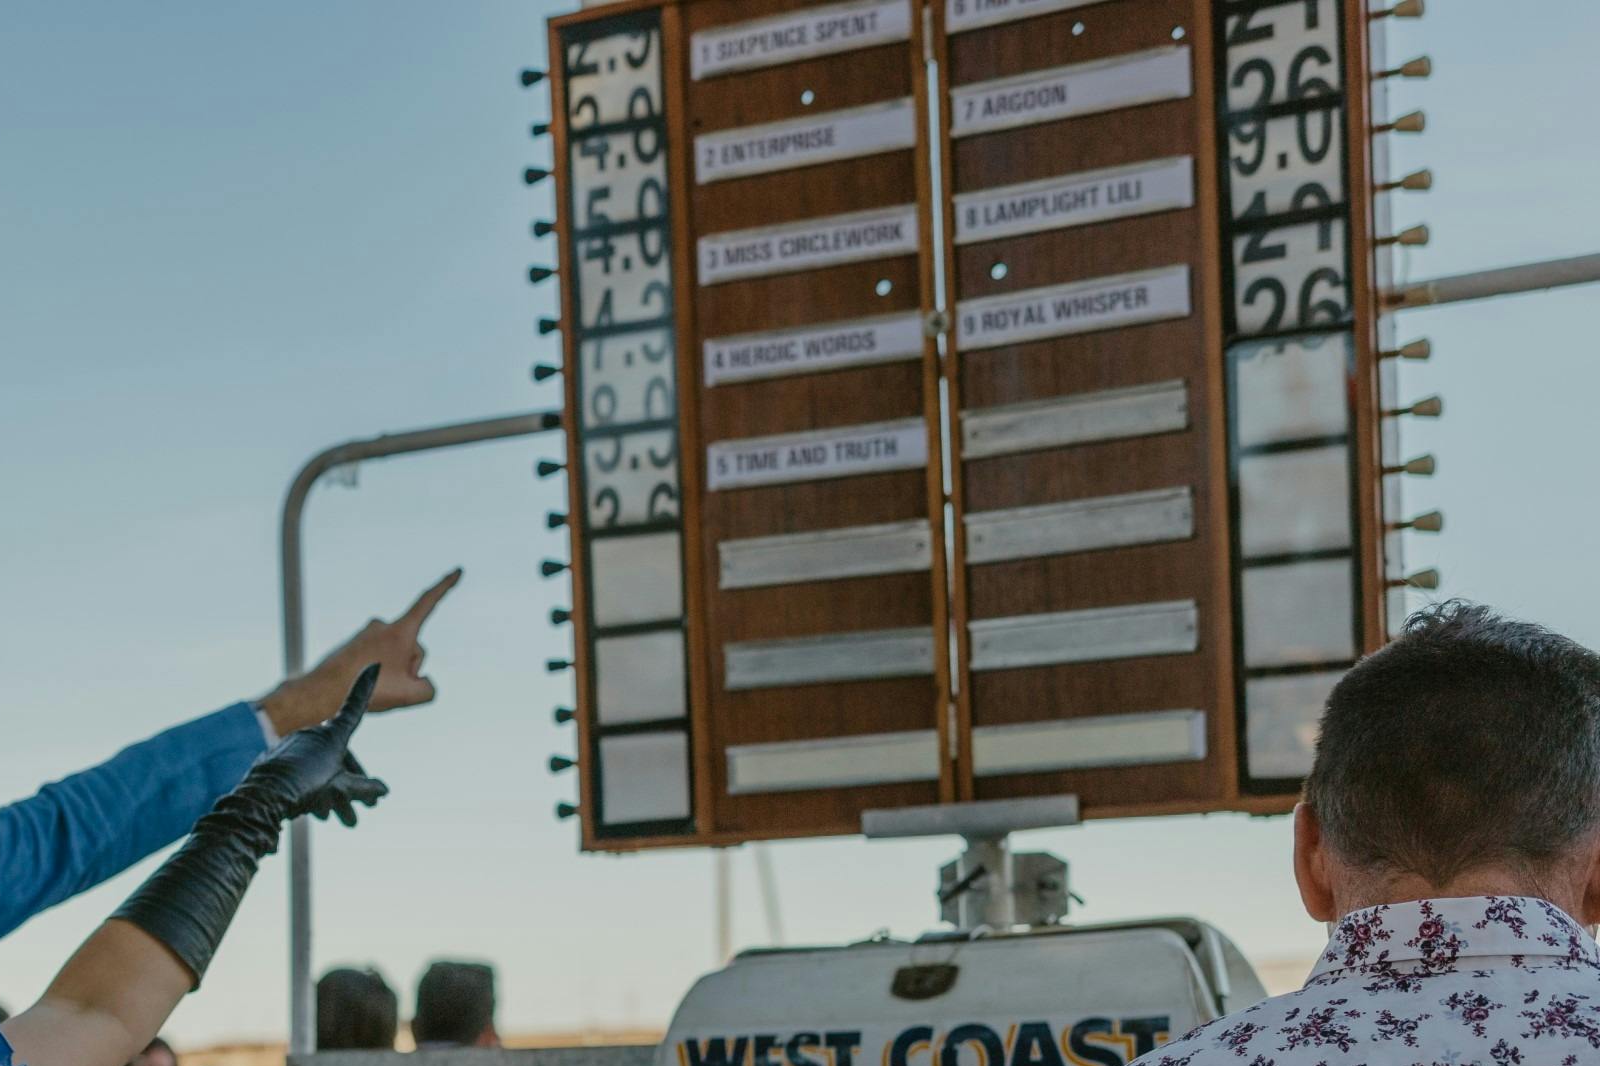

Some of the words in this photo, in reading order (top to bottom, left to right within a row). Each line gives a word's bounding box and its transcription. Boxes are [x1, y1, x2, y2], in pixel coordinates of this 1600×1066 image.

[701, 45, 711, 63] 1
[715, 24, 810, 62] SIXPENCE
[813, 11, 879, 42] SPENT
[963, 100, 975, 122] 7
[982, 83, 1069, 118] ARGOON
[703, 149, 716, 169] 2
[720, 125, 836, 166] ENTERPRISE
[964, 206, 978, 229] 8
[983, 187, 1100, 227] LAMPLIGHT
[1105, 179, 1144, 206] LILI
[723, 236, 773, 266] MISS
[778, 222, 905, 260] CIRCLEWORK
[963, 314, 976, 336] 9
[981, 303, 1047, 333] ROYAL
[1052, 287, 1150, 322] WHISPER
[712, 351, 725, 370] 4
[729, 341, 798, 369] HEROIC
[803, 330, 877, 359] WORDS
[716, 457, 729, 476] 5
[735, 449, 780, 474] TIME
[785, 444, 828, 469] AND
[833, 436, 898, 464] TRUTH
